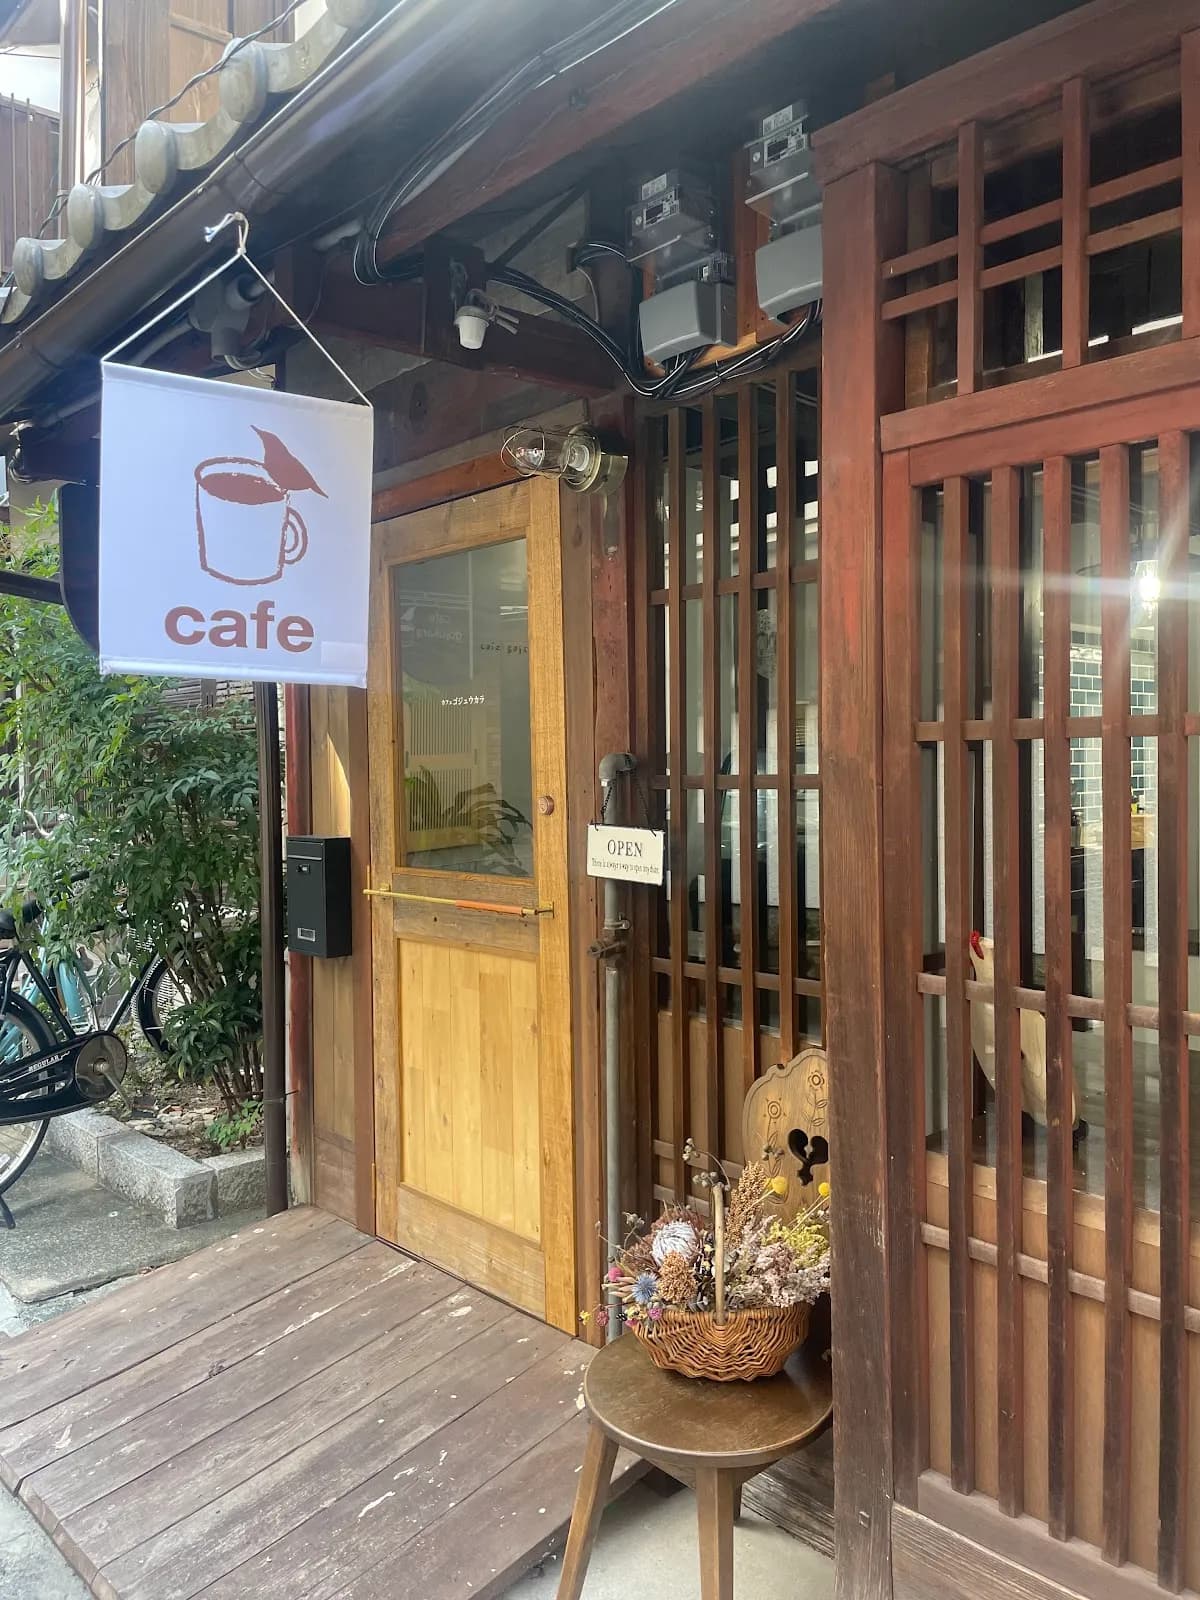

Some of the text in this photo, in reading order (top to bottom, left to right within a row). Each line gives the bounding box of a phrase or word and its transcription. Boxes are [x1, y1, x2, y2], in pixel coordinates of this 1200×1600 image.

[164, 600, 315, 653] cafe
[441, 695, 485, 706] カフェゴジュウカラ
[607, 839, 643, 857] OPEN
[28, 1054, 60, 1072] REGULAR
